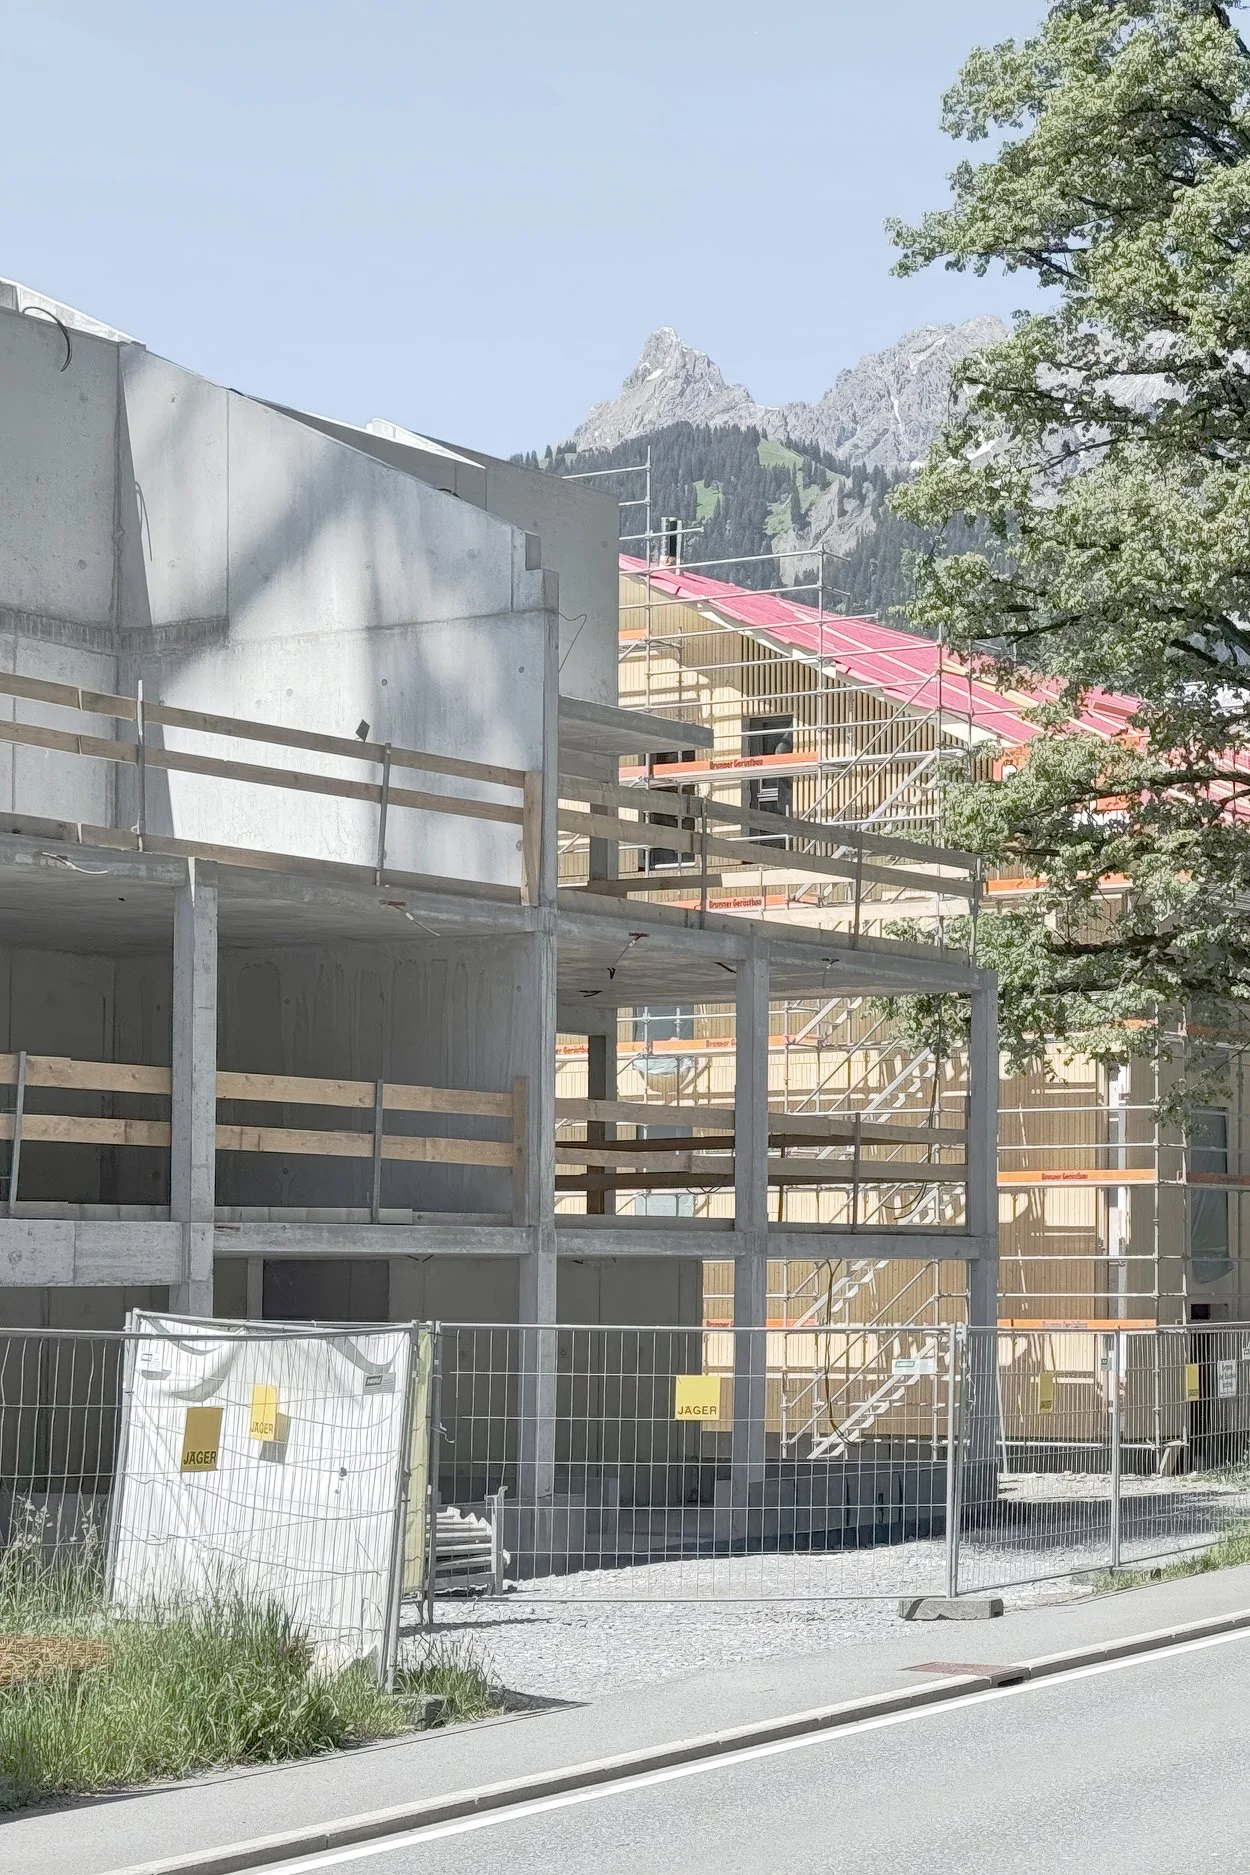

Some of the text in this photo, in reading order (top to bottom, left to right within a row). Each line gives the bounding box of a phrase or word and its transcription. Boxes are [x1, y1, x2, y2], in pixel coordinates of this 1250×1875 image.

[677, 1405, 717, 1415] JÄGER
[250, 1422, 274, 1434] JÄGER
[183, 1450, 217, 1465] JÄGER
